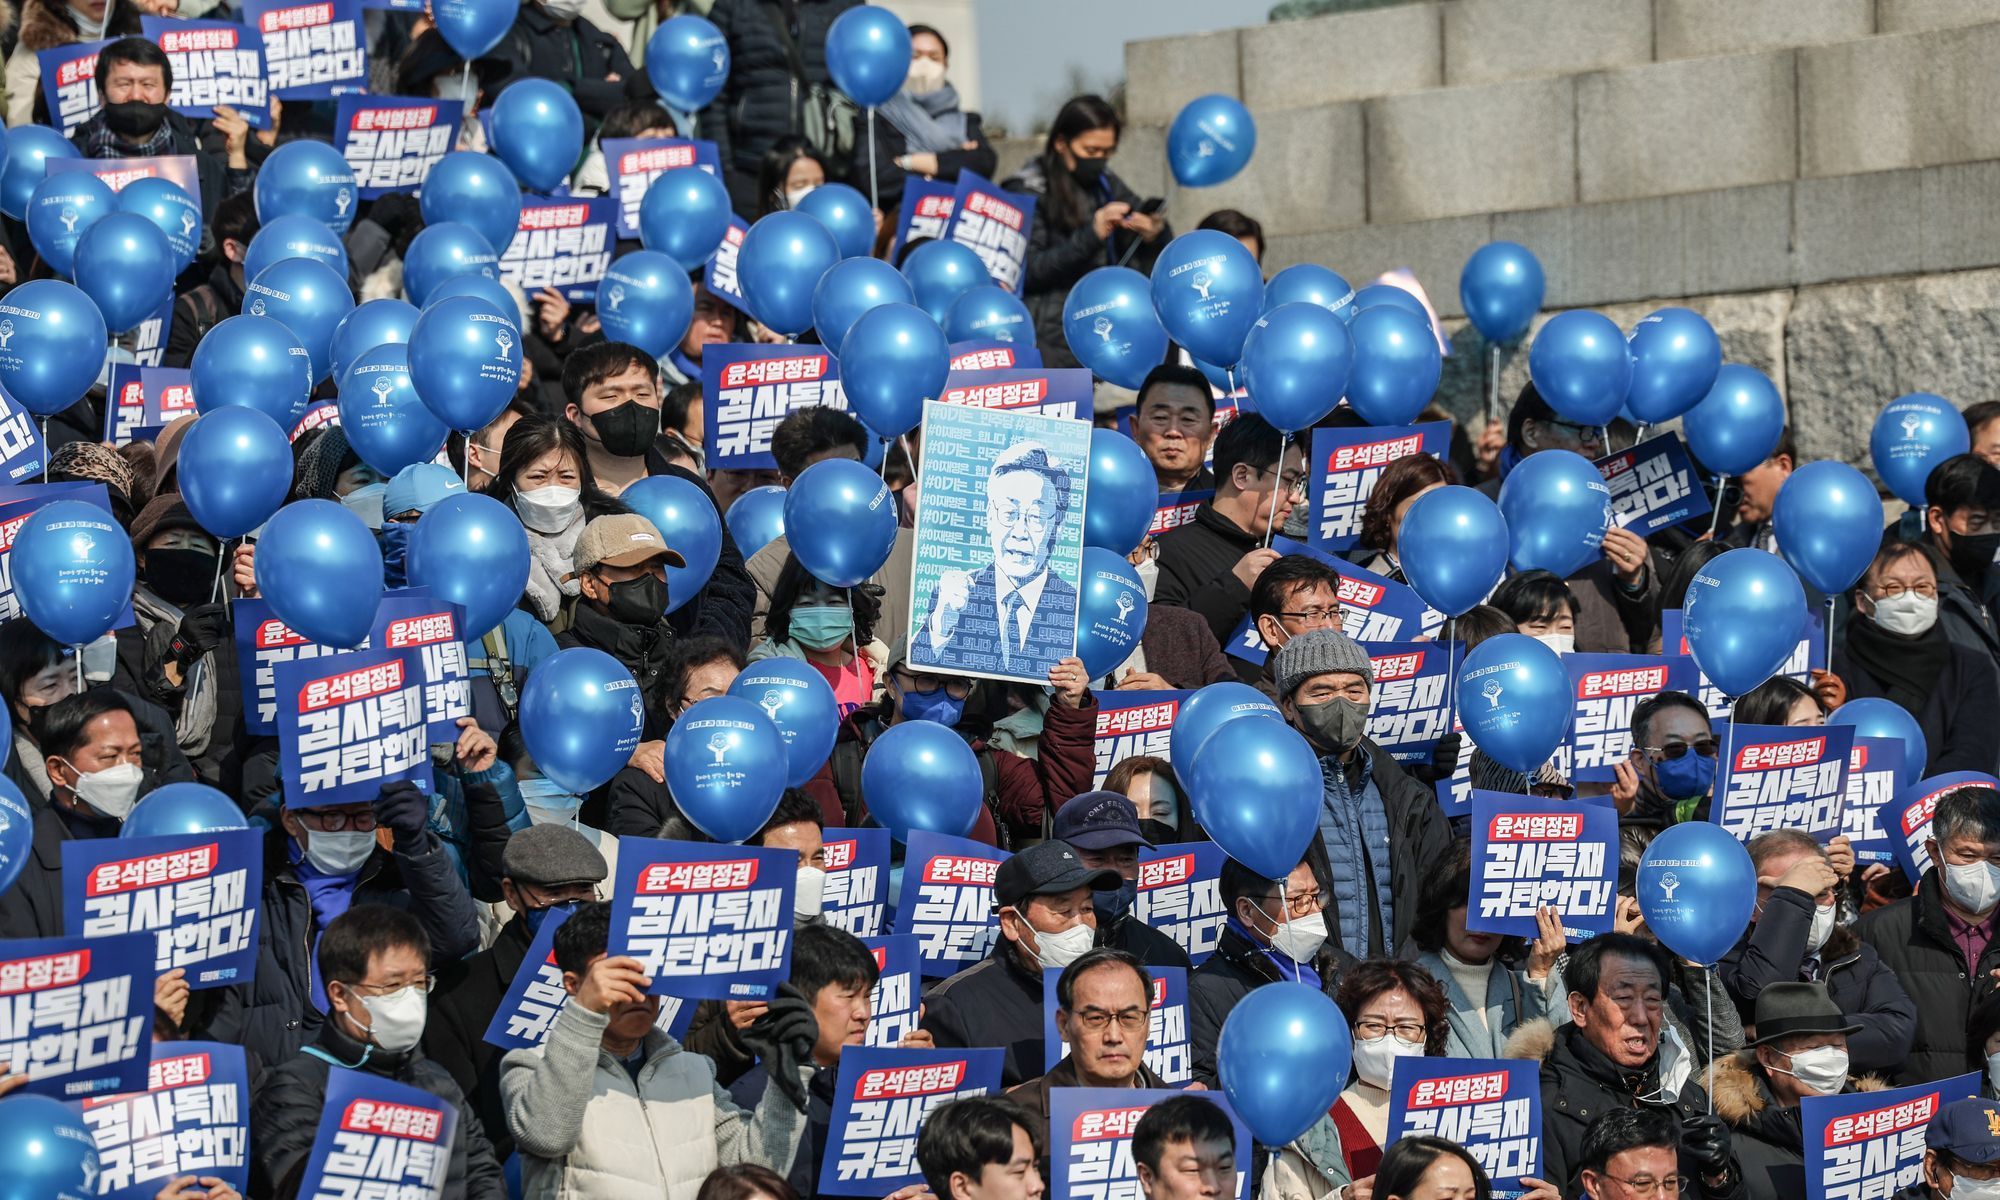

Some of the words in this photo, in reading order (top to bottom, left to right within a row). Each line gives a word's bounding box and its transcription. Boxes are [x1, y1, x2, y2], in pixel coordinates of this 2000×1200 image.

[728, 358, 820, 386] 윤석열정권
[1335, 437, 1419, 469] 윤석열정권
[1608, 452, 1672, 498] 독재
[392, 614, 453, 646] 윤석열정권
[1339, 602, 1402, 642] 독재
[307, 662, 400, 708] 윤석열정권
[1584, 670, 1662, 695] 윤석열정권
[299, 685, 421, 754] 검사독재
[1095, 704, 1173, 735] 윤석열정권
[1367, 707, 1449, 747] 한다!
[1575, 695, 1638, 733] 검사
[301, 724, 427, 793] 규탄한다!
[1742, 739, 1822, 769] 윤석열정권
[1728, 760, 1842, 807] 검사독재
[1496, 817, 1578, 838] 윤석열정권
[96, 847, 210, 893] 윤석열정권
[646, 863, 752, 890] 윤석열정권
[1483, 842, 1605, 879] 검사독재
[83, 868, 247, 938] 검사독재
[823, 866, 878, 907] 독재
[913, 885, 999, 921] 검사
[1480, 880, 1612, 918] 규탄한다!
[627, 888, 782, 935] 검사독재
[155, 909, 255, 971] 한다!
[627, 929, 788, 977] 규탄한다!
[0, 953, 81, 989] 열정권
[0, 975, 131, 1041] 사독재
[863, 1064, 960, 1096] 윤석열정권
[1415, 1074, 1503, 1105] 윤석열정권
[83, 1083, 237, 1143] 검사독재
[350, 1101, 439, 1139] 윤석열정권
[1833, 1096, 1933, 1143] 윤석열정권
[98, 1126, 246, 1195] 규탄한다!
[1823, 1124, 1928, 1186] 검사독
